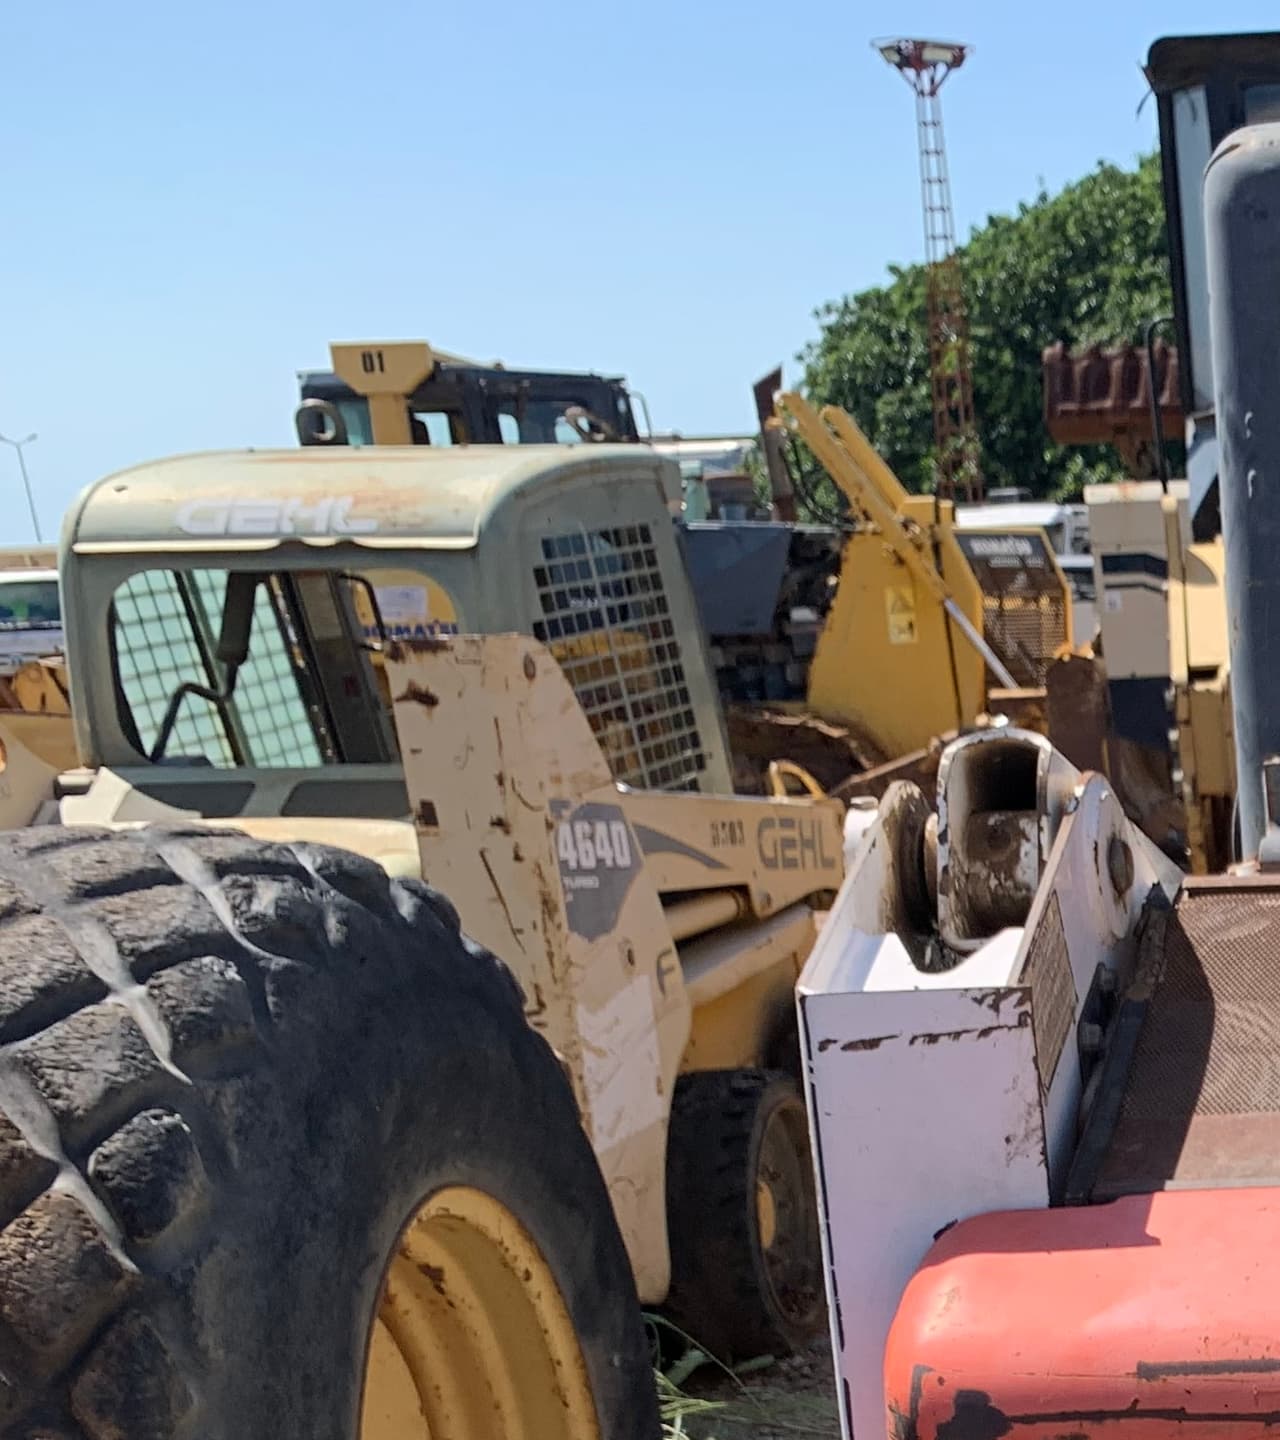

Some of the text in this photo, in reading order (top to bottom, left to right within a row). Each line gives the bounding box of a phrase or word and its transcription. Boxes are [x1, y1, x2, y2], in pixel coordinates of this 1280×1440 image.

[176, 497, 379, 535] GEHL
[558, 820, 632, 870] 4640
[757, 816, 836, 869] GEHL
